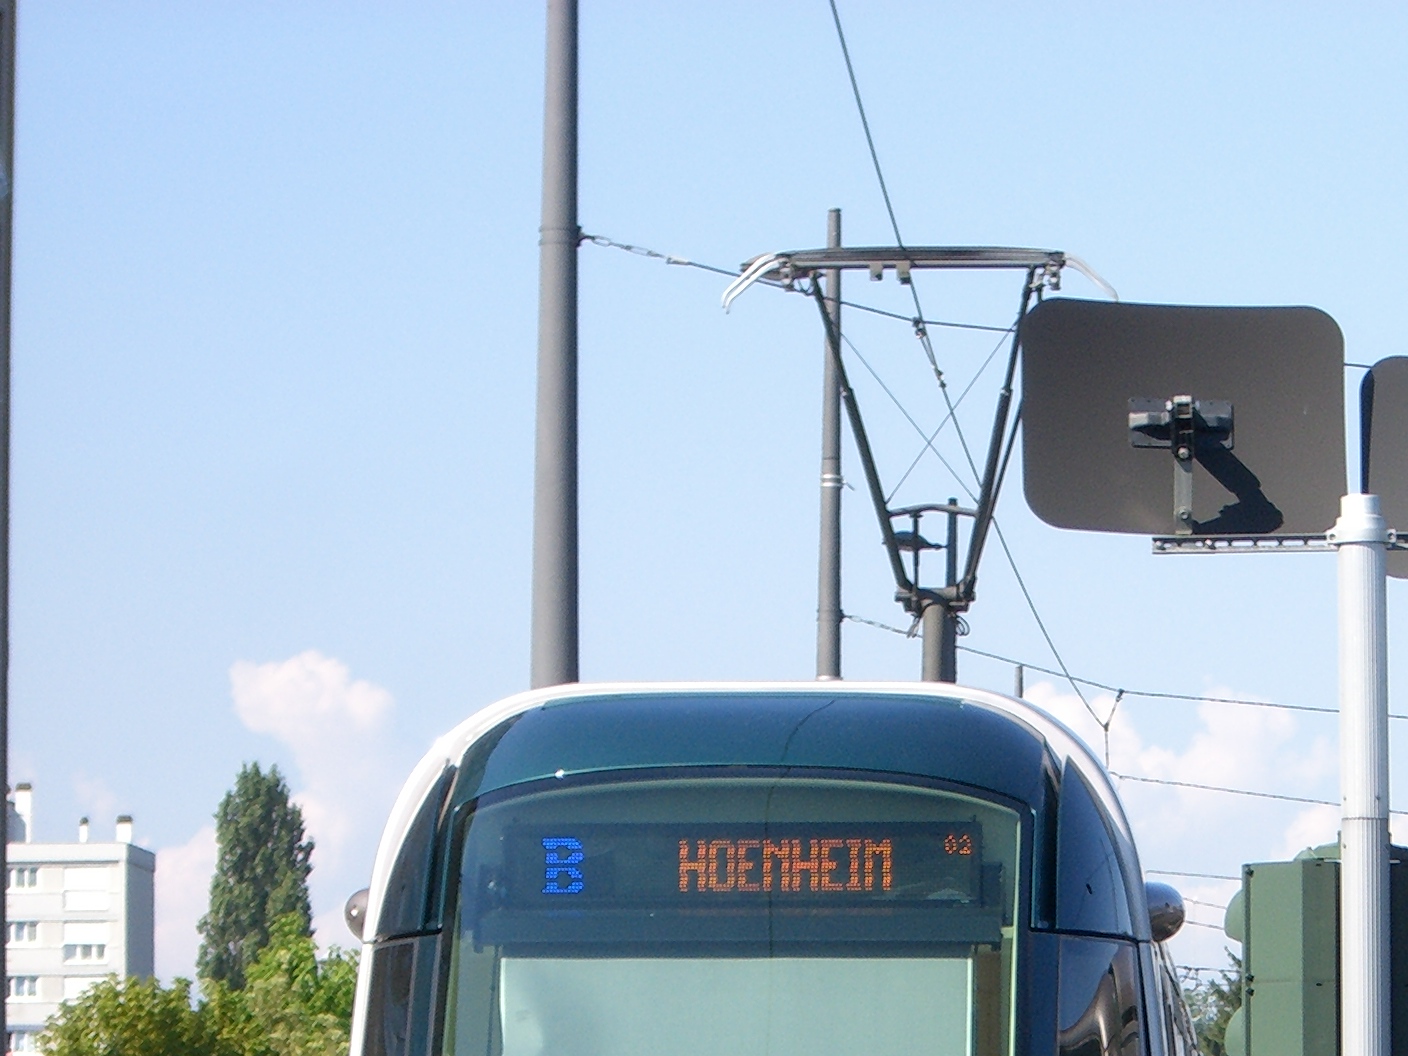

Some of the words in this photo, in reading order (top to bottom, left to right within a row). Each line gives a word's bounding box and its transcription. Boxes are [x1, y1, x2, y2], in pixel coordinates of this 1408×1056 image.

[542, 837, 584, 894] B
[678, 839, 892, 892] HOENHEIM
[944, 834, 971, 855] 02
